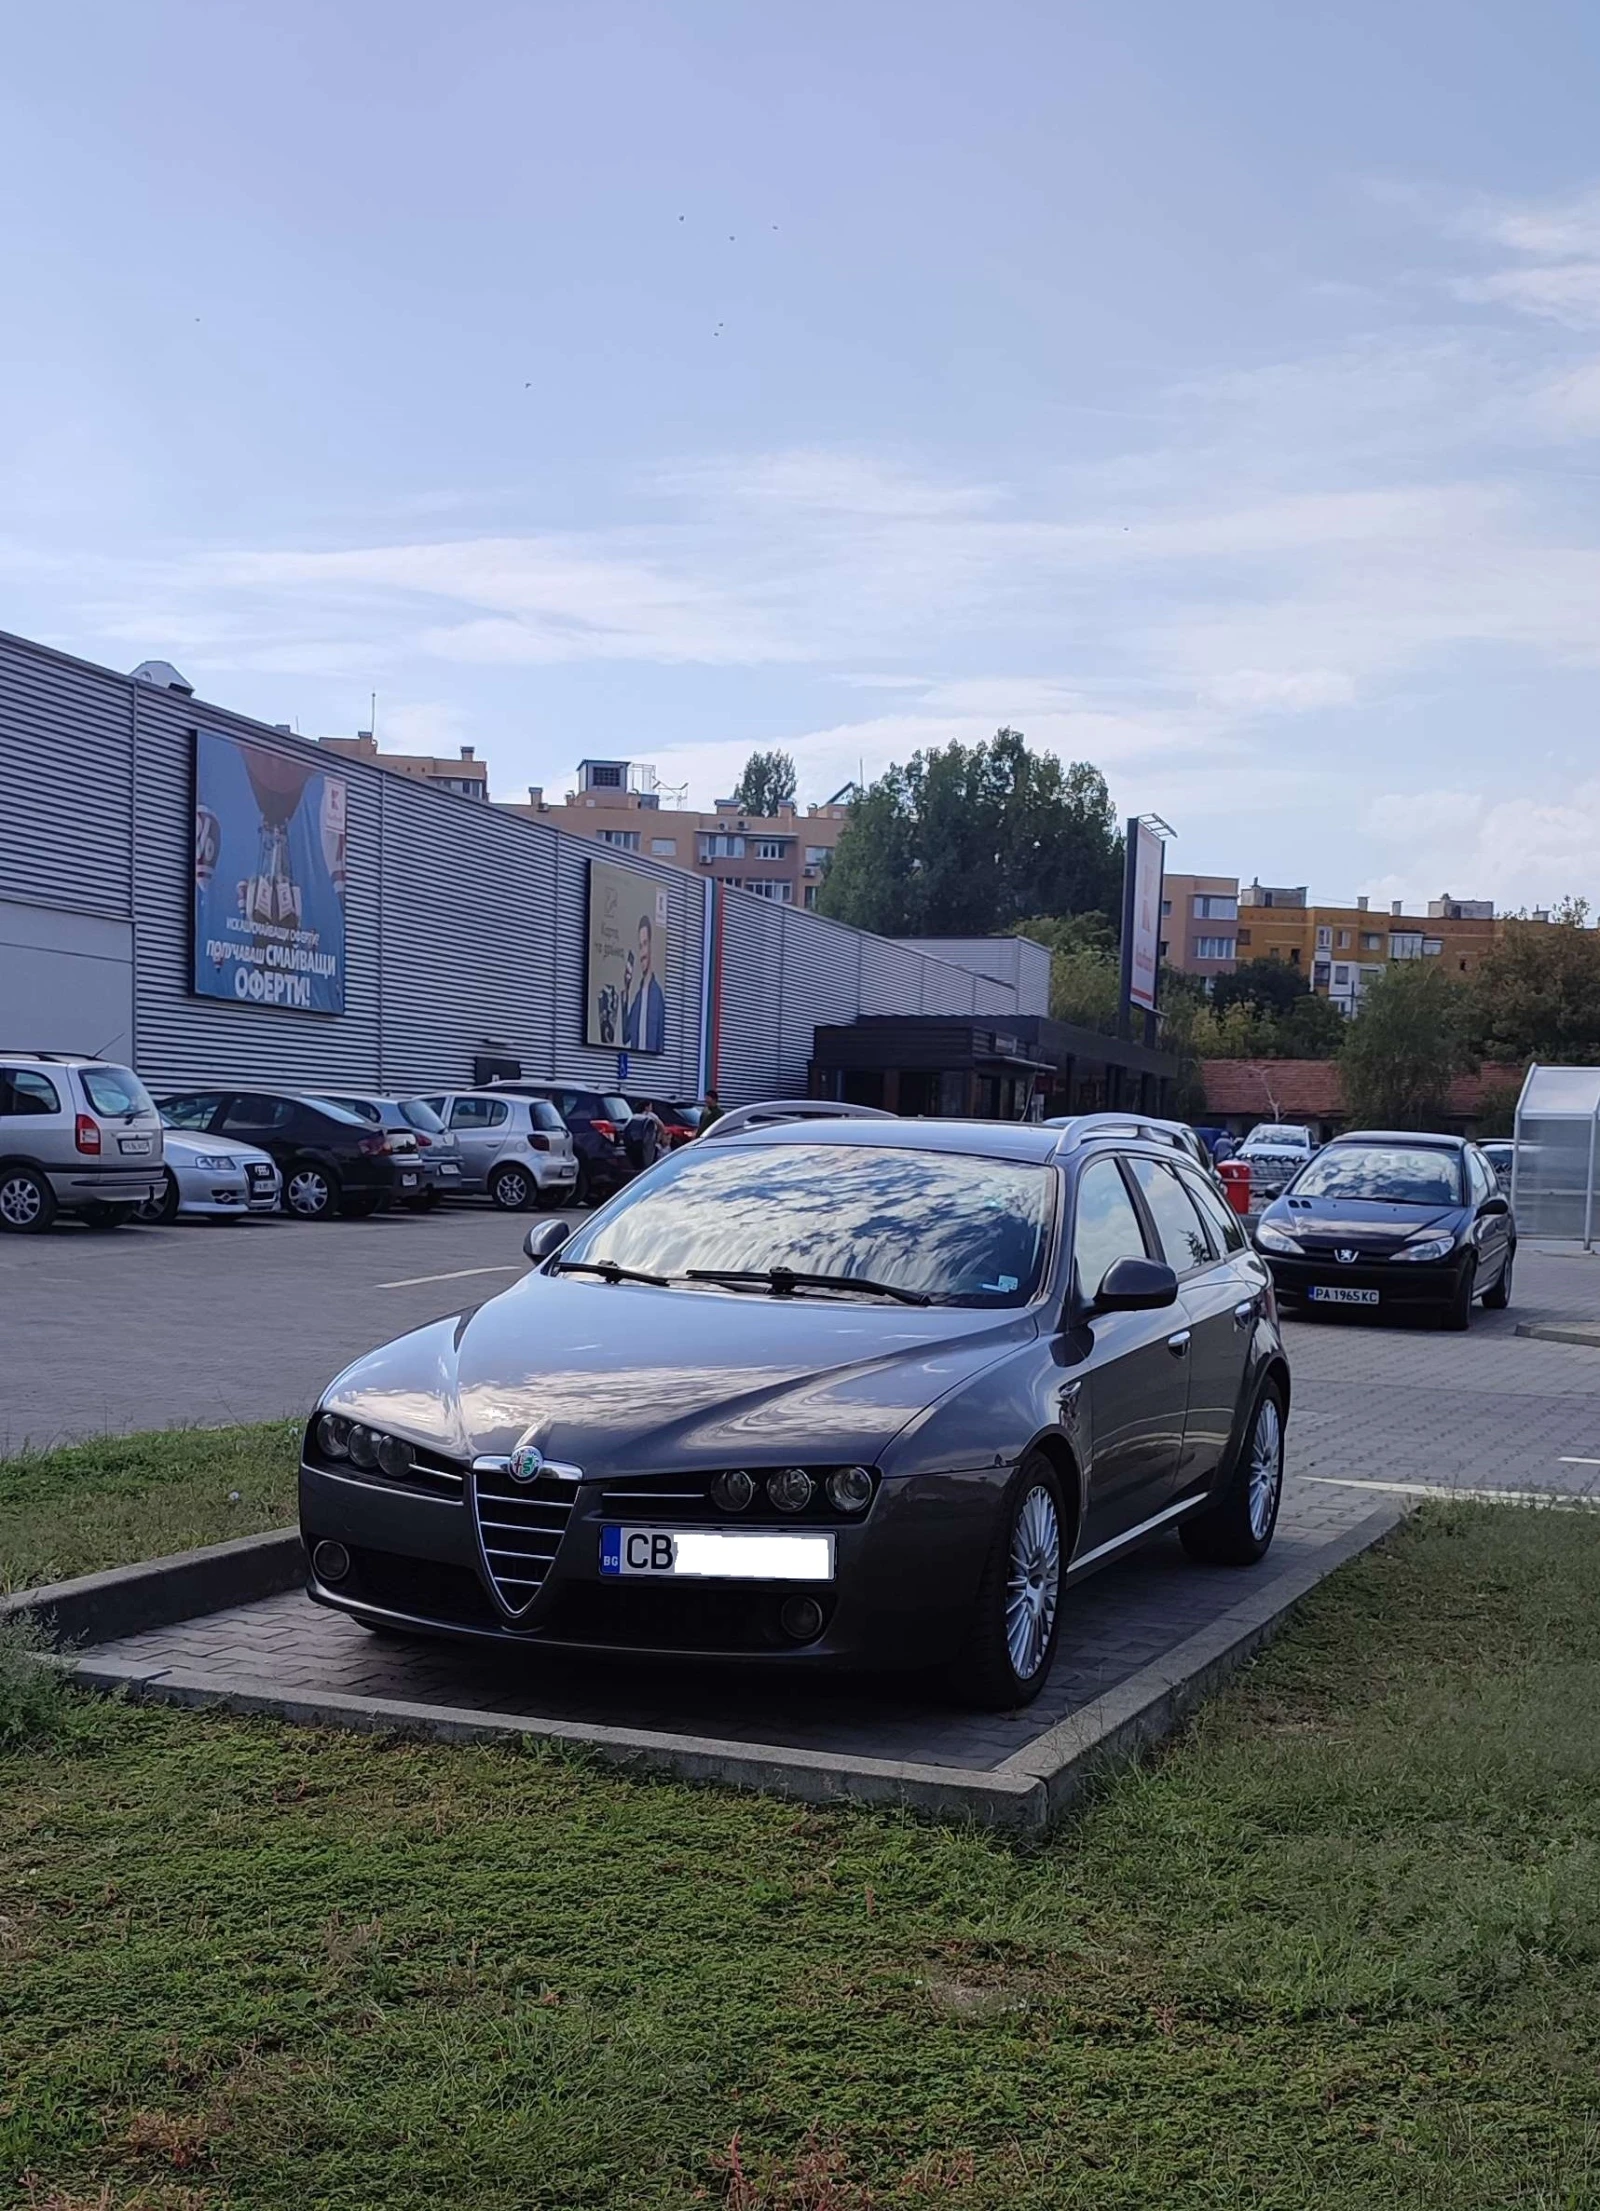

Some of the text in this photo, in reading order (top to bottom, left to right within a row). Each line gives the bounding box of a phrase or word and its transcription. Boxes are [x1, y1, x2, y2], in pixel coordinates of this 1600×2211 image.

[206, 939, 336, 979] ПОЛУЧАВАШ СМАЙВАЩИ
[235, 967, 311, 1007] ОФЕРТИ!
[603, 1555, 619, 1567] BG
